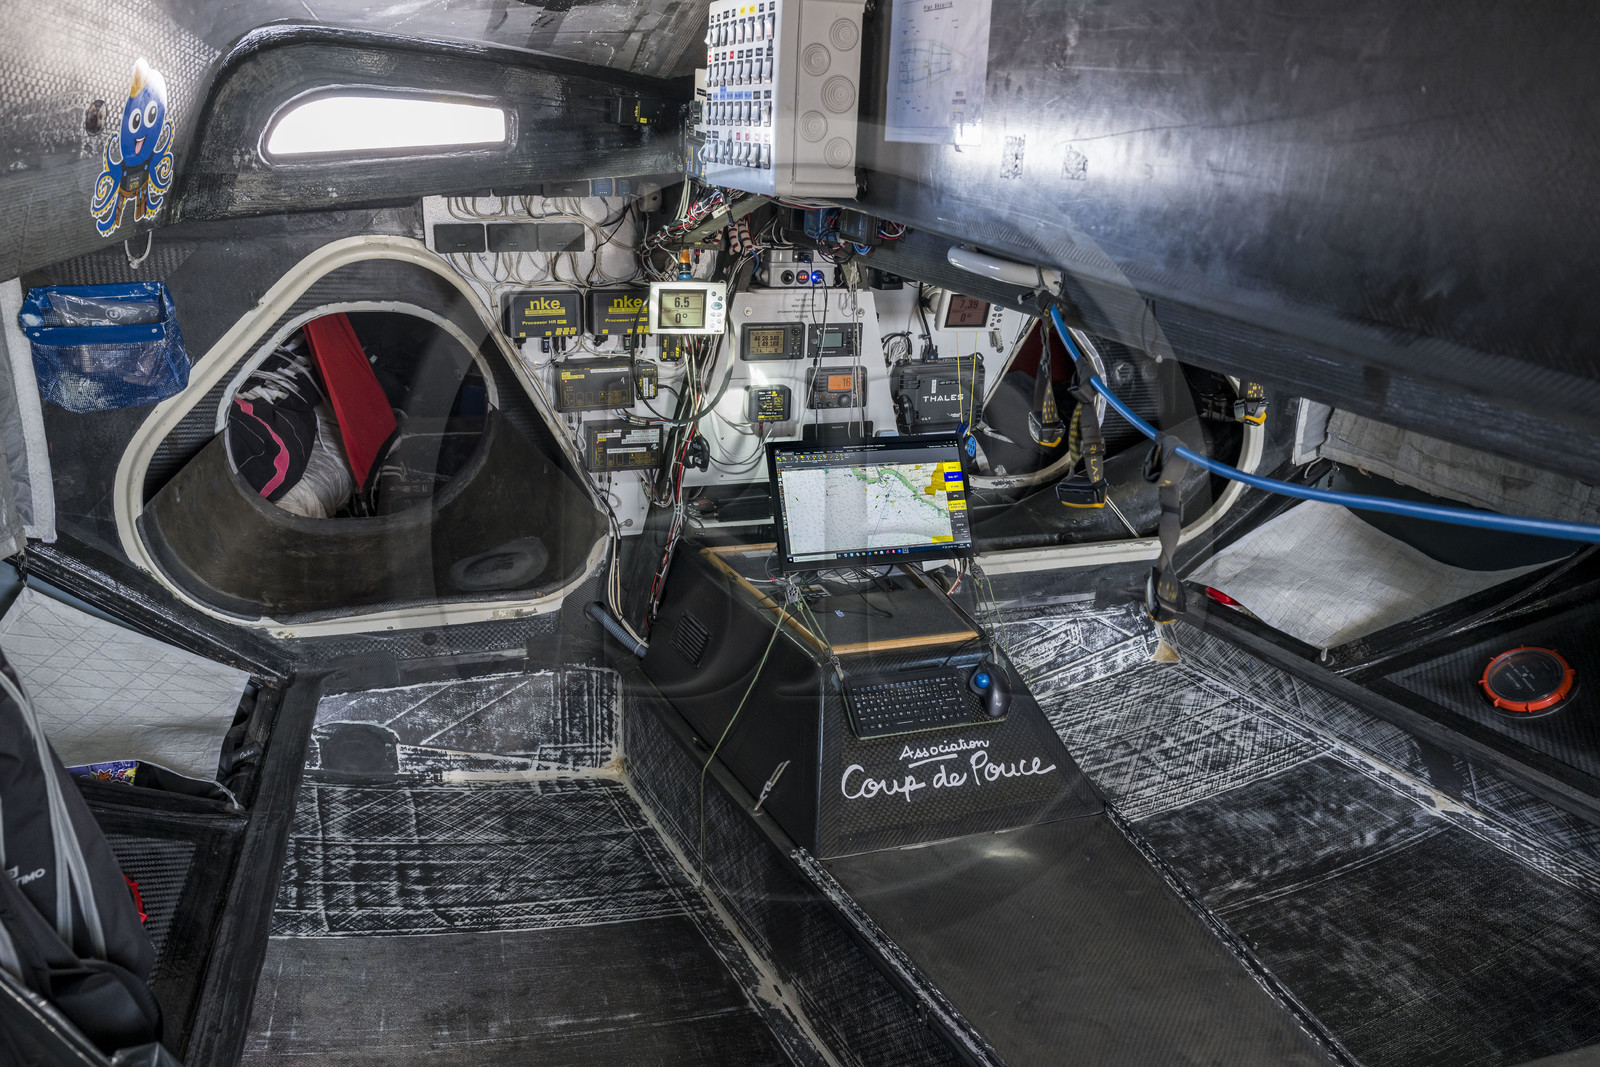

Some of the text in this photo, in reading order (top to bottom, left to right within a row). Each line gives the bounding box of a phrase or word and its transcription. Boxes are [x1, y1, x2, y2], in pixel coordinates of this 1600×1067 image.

[529, 297, 560, 310] nke
[613, 295, 643, 308] nke
[674, 296, 690, 308] 6.5
[960, 299, 979, 309] 7.39
[842, 377, 852, 388] 16
[922, 393, 964, 403] THALES
[898, 738, 989, 760] Association
[841, 750, 1056, 802] Coup de Pouce
